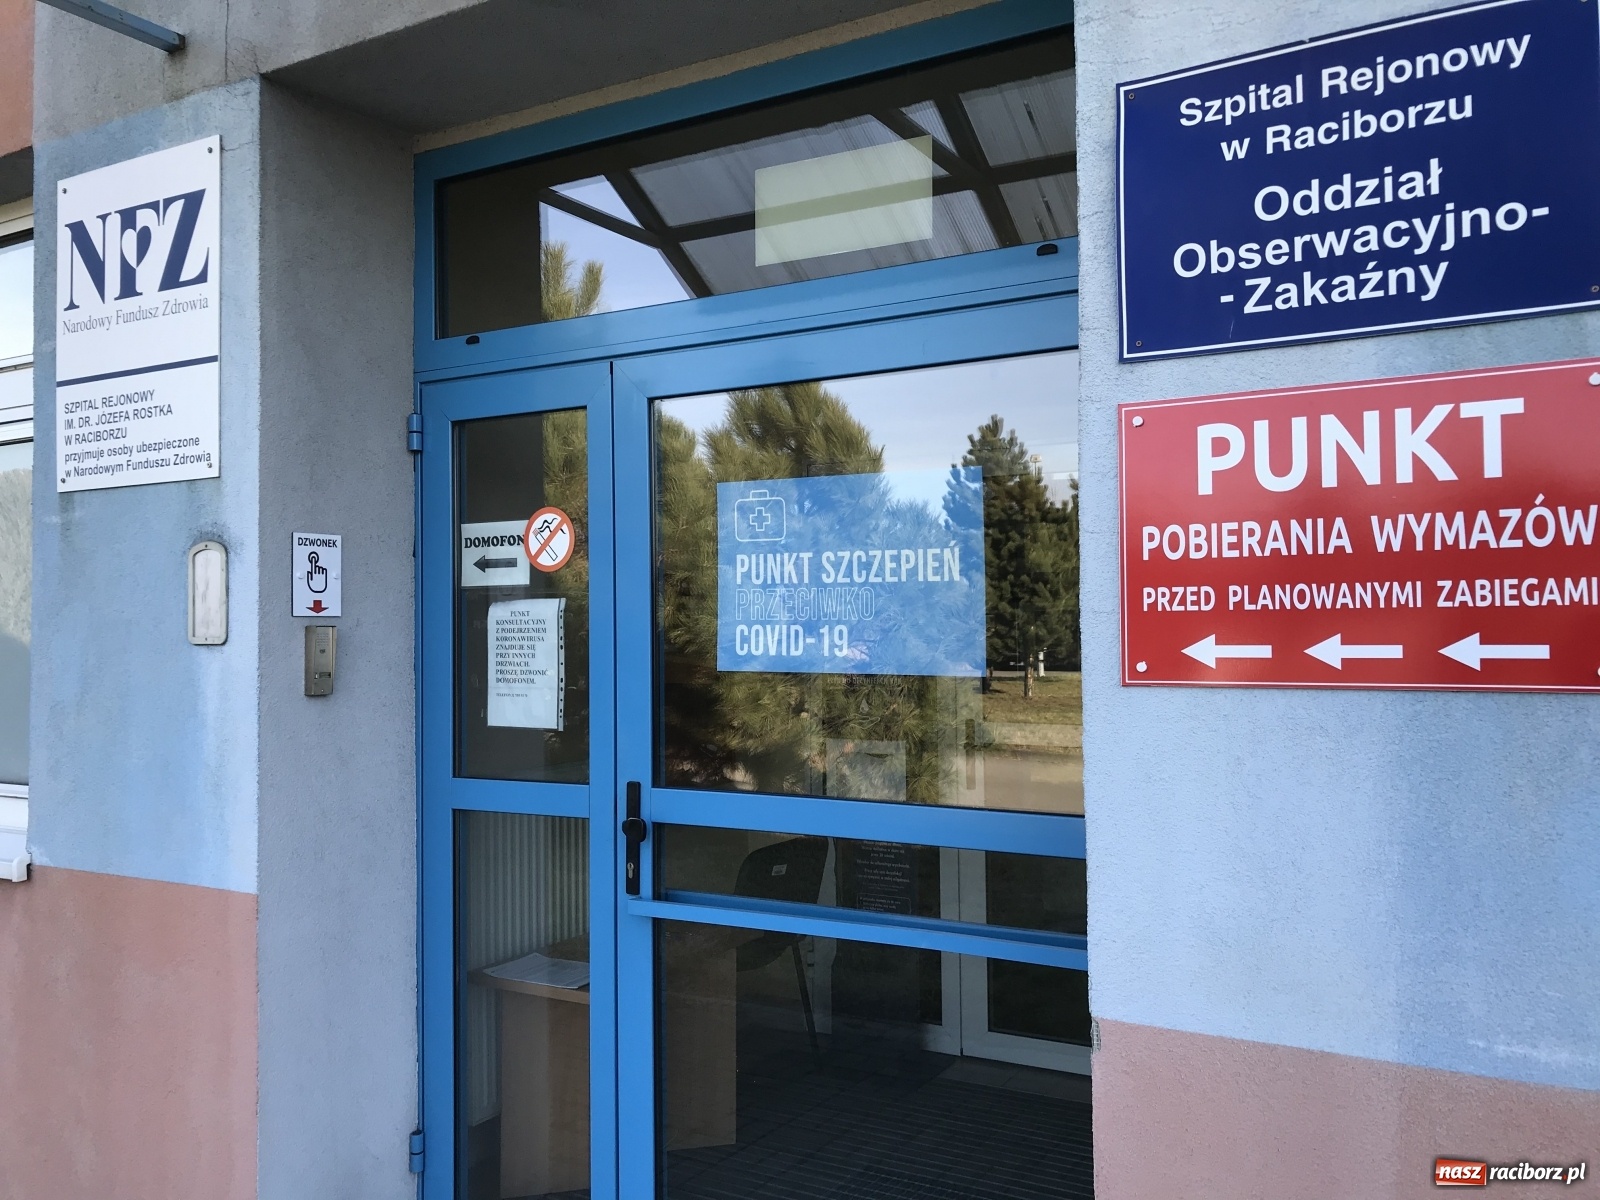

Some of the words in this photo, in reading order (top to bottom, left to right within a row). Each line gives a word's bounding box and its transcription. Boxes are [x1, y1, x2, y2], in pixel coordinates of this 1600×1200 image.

[1179, 75, 1304, 127] Szpital
[1321, 33, 1532, 98] Rejonowy
[1220, 137, 1250, 161] w
[1265, 94, 1473, 155] Raciborzu
[1254, 158, 1443, 222] Oddział
[63, 187, 210, 312] NFZ
[1173, 202, 1550, 279] Obserwacyjno-
[62, 312, 112, 335] Narodowy
[115, 305, 159, 326] Fundusz
[162, 293, 209, 317] Zdrowia
[64, 397, 99, 414] SZPITAL
[101, 389, 155, 409] REJONOWY
[64, 415, 76, 430] IM.
[78, 412, 94, 428] DR.
[95, 405, 131, 425] JÓZEFA
[133, 404, 173, 421] ROSTKA
[64, 434, 73, 447] W
[74, 427, 127, 445] RACIBORZU
[64, 449, 105, 465] przyjmuje
[107, 444, 134, 458] osoby
[136, 436, 200, 454] ubezpieczone
[1197, 397, 1525, 496] PUNKT
[65, 469, 72, 478] w
[73, 462, 124, 478] Narodowym
[126, 457, 171, 471] Funduszu
[173, 451, 211, 466] Zdrowia
[297, 537, 338, 548] DZWONEK
[464, 534, 525, 549] DOMOFON
[1142, 516, 1353, 561] POBIERANIA
[1371, 493, 1599, 553] WYMAZÓW
[736, 552, 813, 585] PUNKT
[821, 540, 960, 583] SZCZEPIEŃ
[736, 587, 875, 620] PRZECIWKO
[1142, 585, 1215, 612] PRZED
[1228, 581, 1422, 611] PLANOWANYMI
[1437, 576, 1599, 608] ZABIEGAMI
[735, 624, 848, 657] COVID-19
